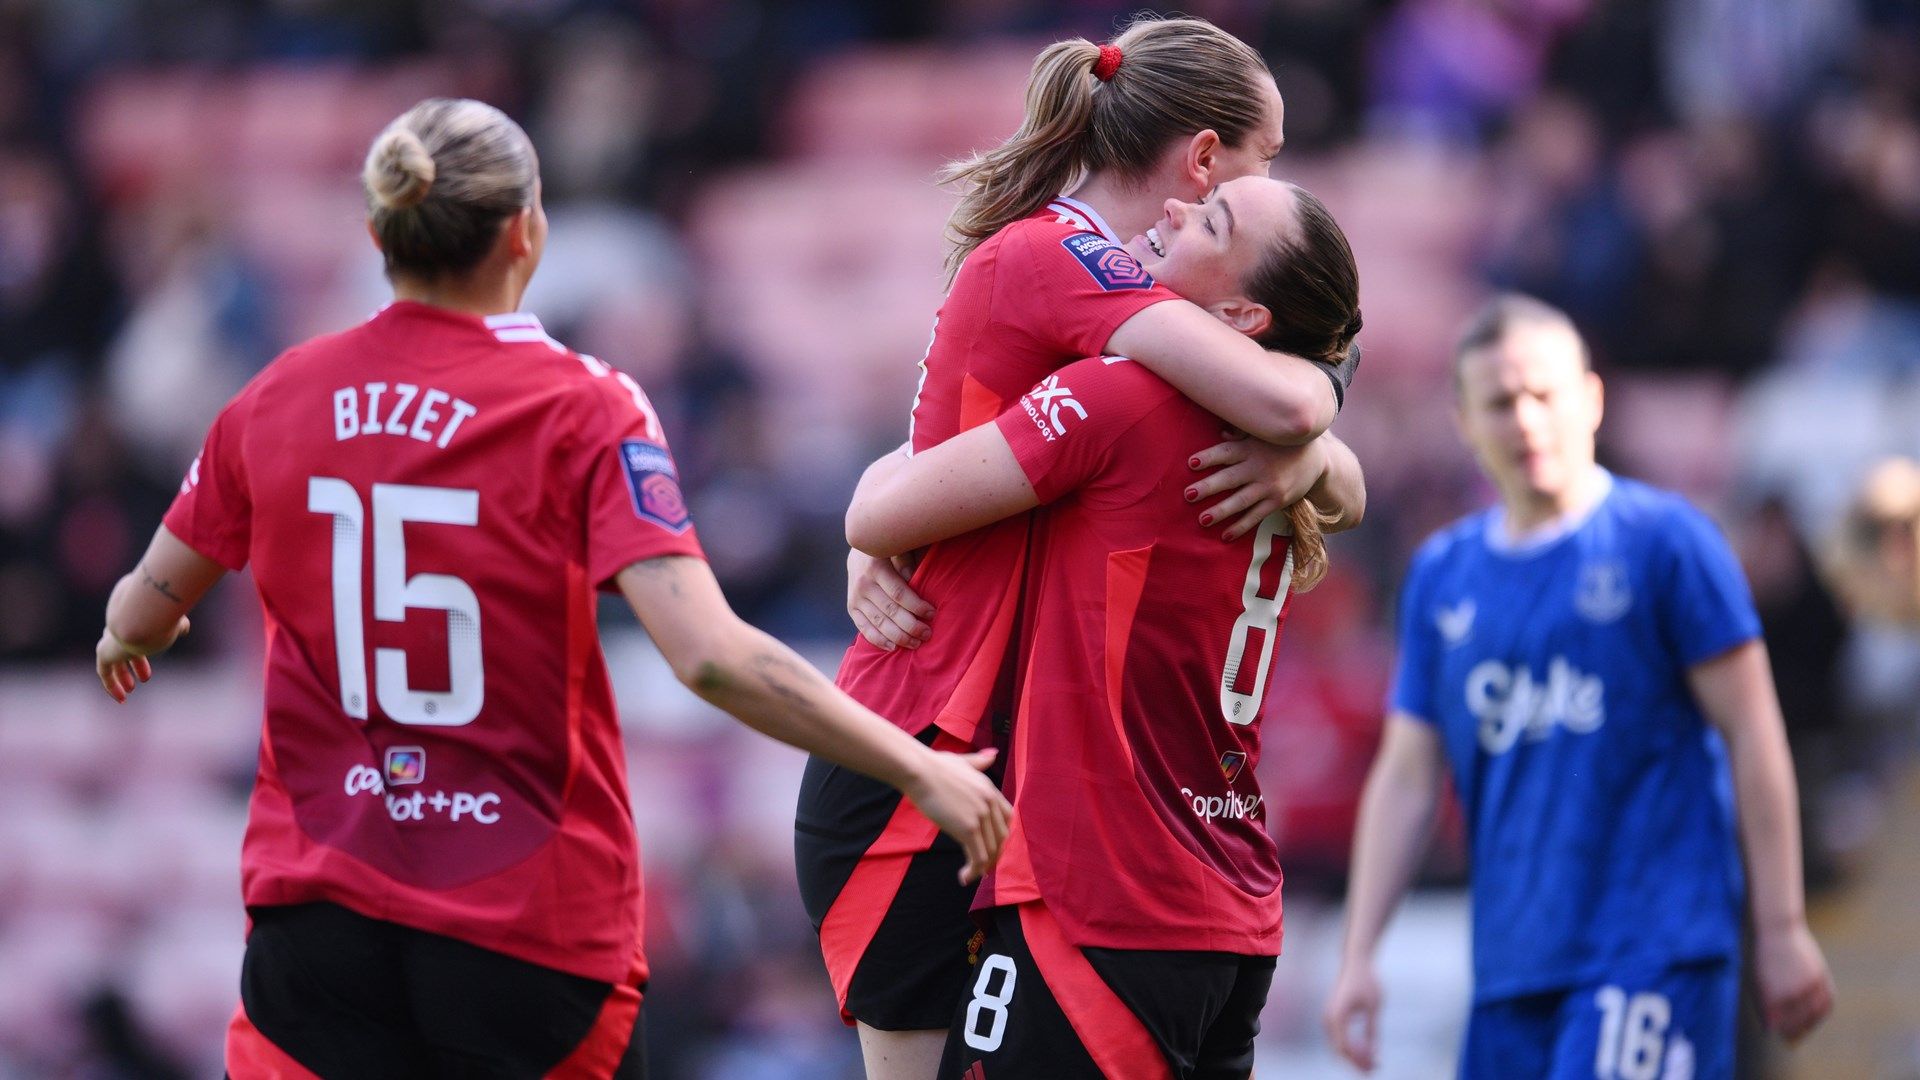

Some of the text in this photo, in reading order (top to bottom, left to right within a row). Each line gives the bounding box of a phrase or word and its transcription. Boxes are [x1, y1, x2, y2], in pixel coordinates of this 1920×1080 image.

[333, 382, 477, 450] BIZET
[308, 476, 485, 726] 15
[1221, 508, 1295, 726] 8
[964, 953, 1017, 1052] 8
